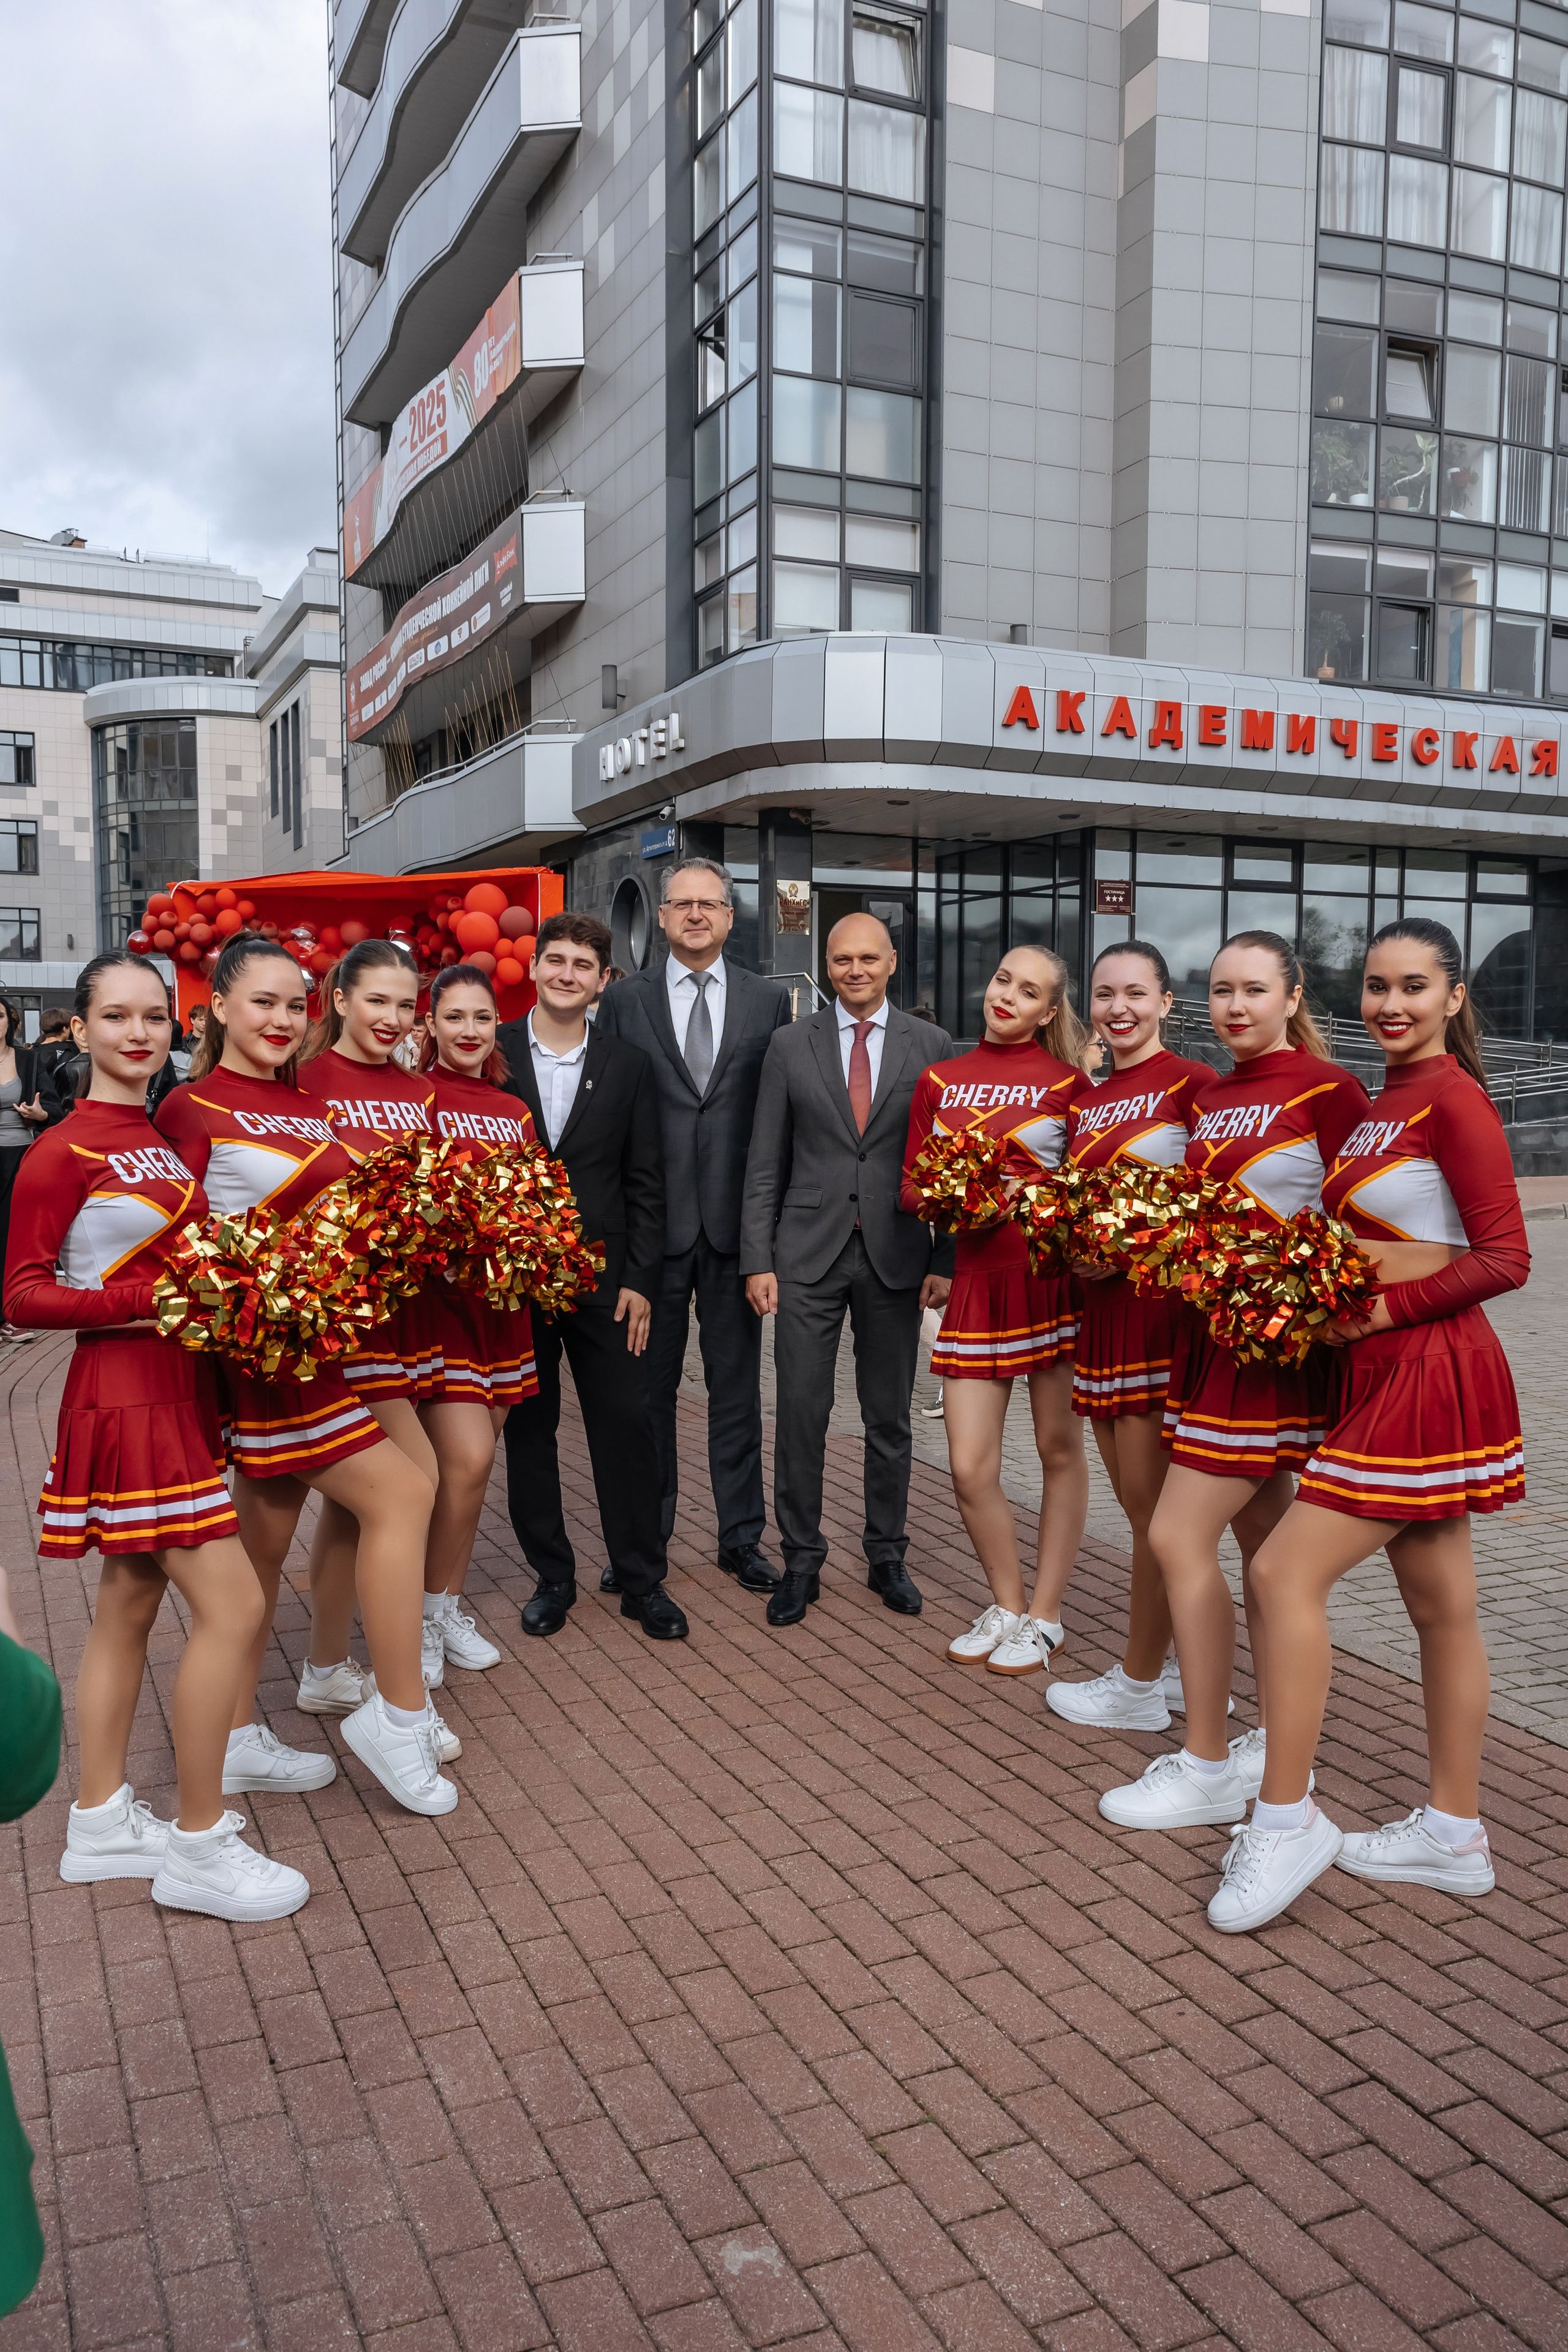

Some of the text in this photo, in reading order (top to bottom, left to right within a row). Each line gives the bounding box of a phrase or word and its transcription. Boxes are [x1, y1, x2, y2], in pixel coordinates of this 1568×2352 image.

[474, 342, 489, 399] 80
[409, 379, 447, 454] 2025
[417, 435, 442, 473] ПОБЕДОЙ
[442, 571, 474, 618] ХОККЕЙНОЙ
[474, 560, 489, 593] ЛИГИ
[599, 712, 685, 782] HOTEL
[1002, 685, 1558, 777] АКАДЕМИЧЕСКАЯ
[668, 828, 675, 848] 62
[780, 898, 807, 907] РАНХиГС
[326, 1099, 432, 1131] CHERRY
[940, 1084, 1049, 1110] CHERRY
[1075, 1091, 1166, 1137] CHERRY
[233, 1110, 342, 1145] CHERRY
[437, 1110, 526, 1144] CHERRY
[1189, 1104, 1283, 1143] CHERRY
[1336, 1121, 1406, 1156] ERRY
[107, 1147, 196, 1184] CHERR
